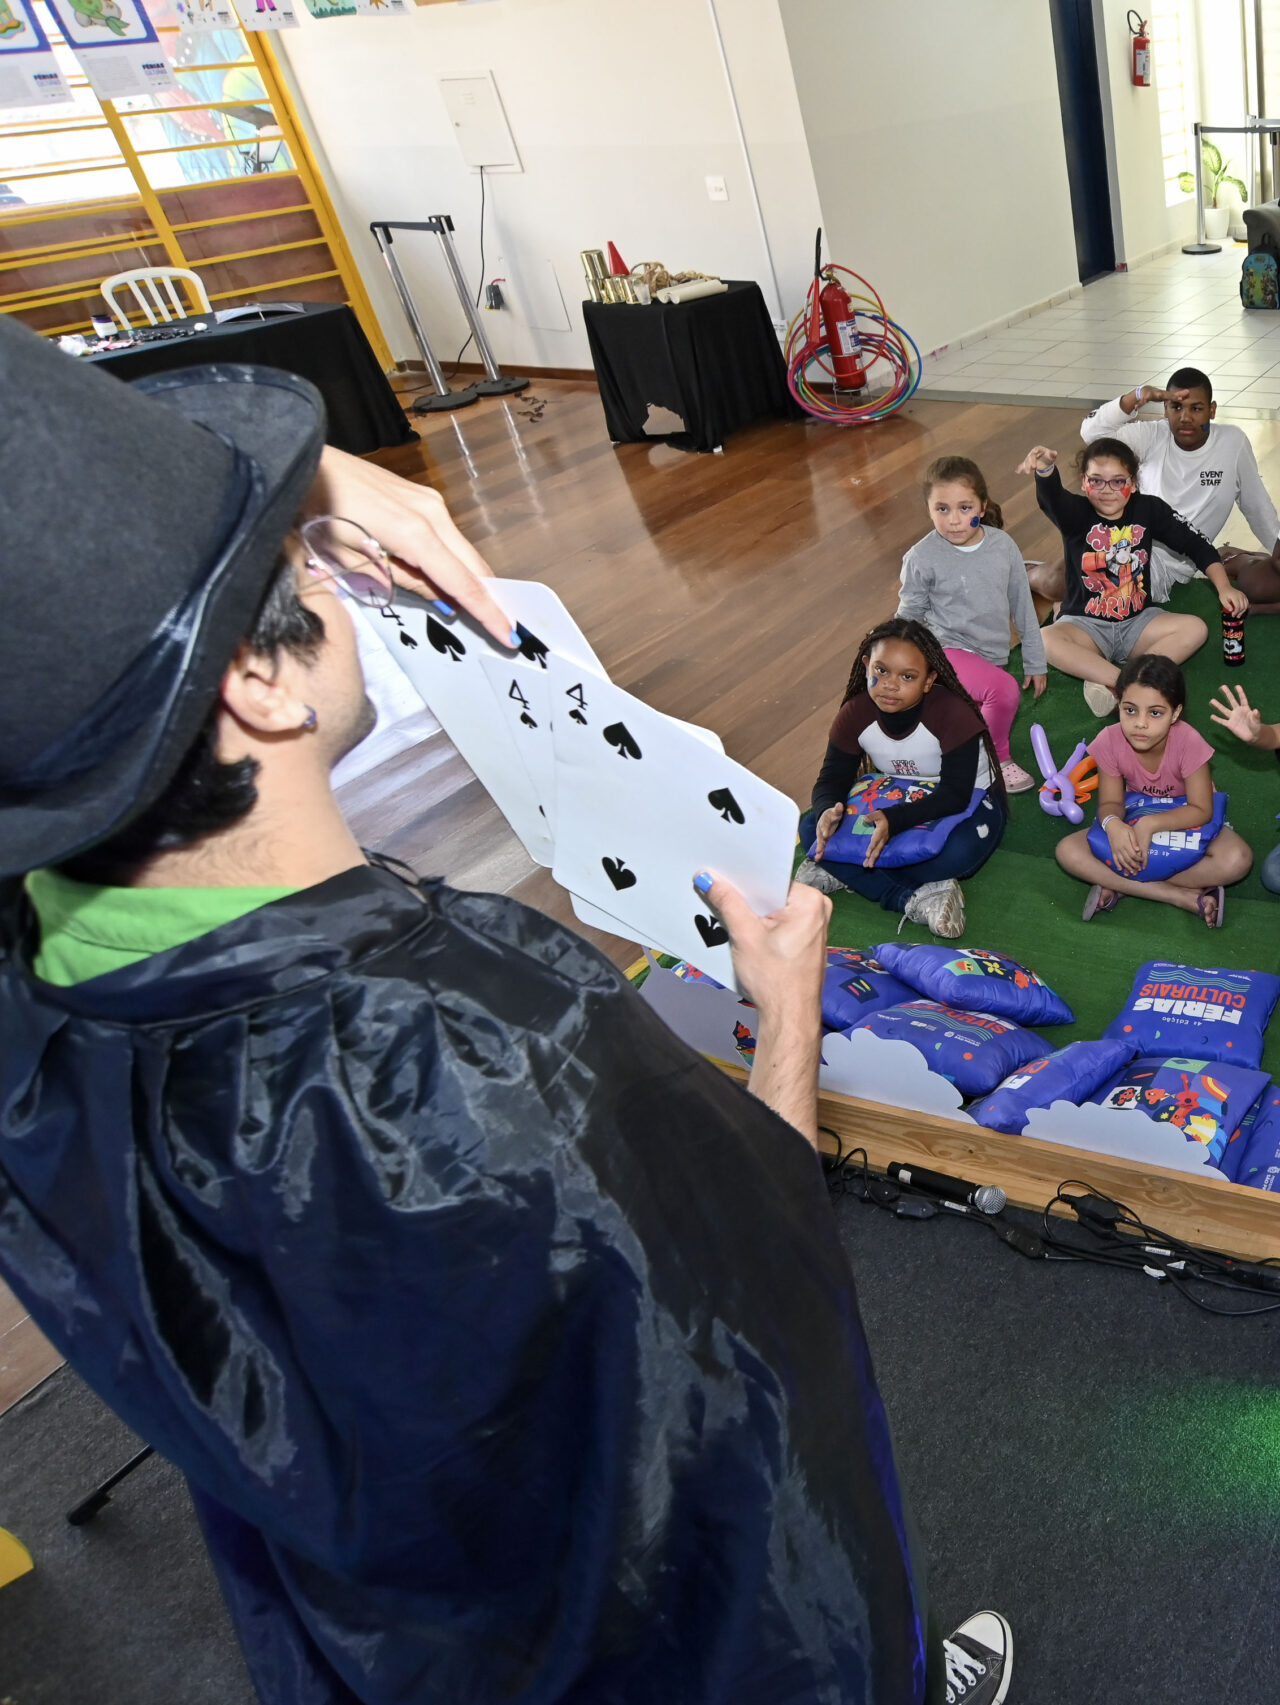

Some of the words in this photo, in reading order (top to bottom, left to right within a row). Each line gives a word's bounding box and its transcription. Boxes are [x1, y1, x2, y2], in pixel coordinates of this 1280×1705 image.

[1200, 470, 1224, 478] EVENT
[509, 679, 531, 710] 4
[566, 683, 588, 710] 4
[1151, 830, 1202, 851] FÉR
[1139, 983, 1247, 1009] CULTURAIS
[1132, 997, 1243, 1025] FÉRIAS
